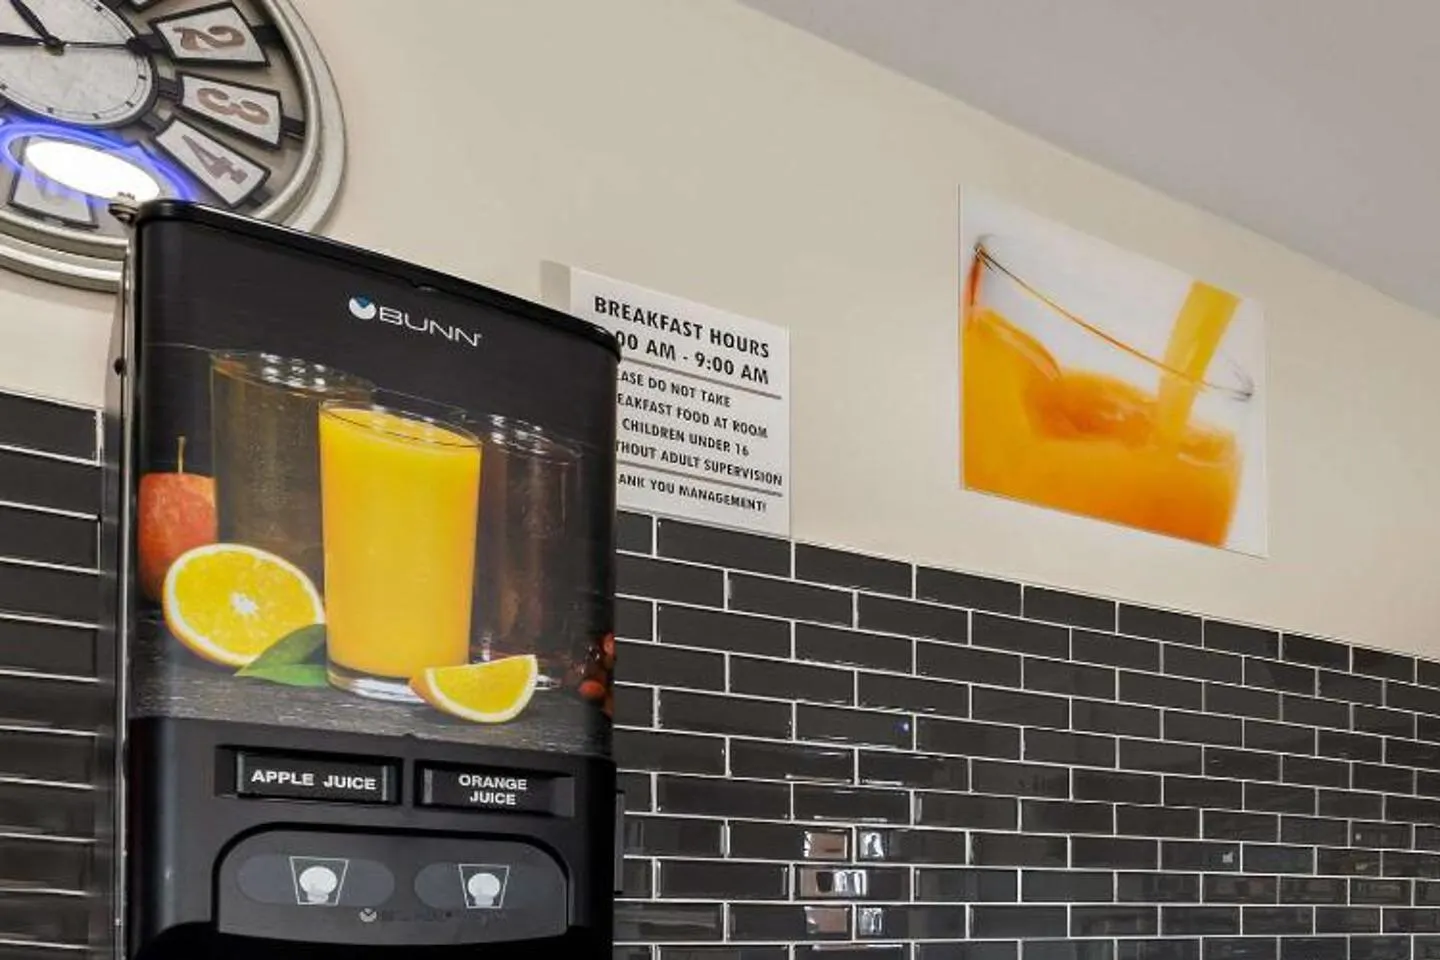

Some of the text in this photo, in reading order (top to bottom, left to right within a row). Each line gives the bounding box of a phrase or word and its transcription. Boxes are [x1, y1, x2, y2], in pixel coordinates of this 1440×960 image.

[196, 87, 270, 126] 3
[181, 133, 249, 186] 4
[379, 306, 479, 348] BUNN
[594, 295, 769, 358] BREAKFAST HOURS
[615, 330, 638, 350] 00
[645, 339, 676, 361] AM
[695, 352, 735, 376] 9:00
[740, 364, 769, 385] AM
[617, 370, 731, 408] ASE DO NOT TAKE
[617, 393, 768, 438] EAKFAST FOOD AT ROOM
[622, 417, 749, 457] CHILDREN UNDER 16
[615, 440, 783, 487] THOUT ADULT SUPERVISION
[618, 473, 646, 488] ANK
[650, 479, 675, 494] YOU
[251, 769, 377, 790] APPLE JUICE
[458, 774, 528, 790] ORANGE
[469, 790, 517, 806] JUICE
